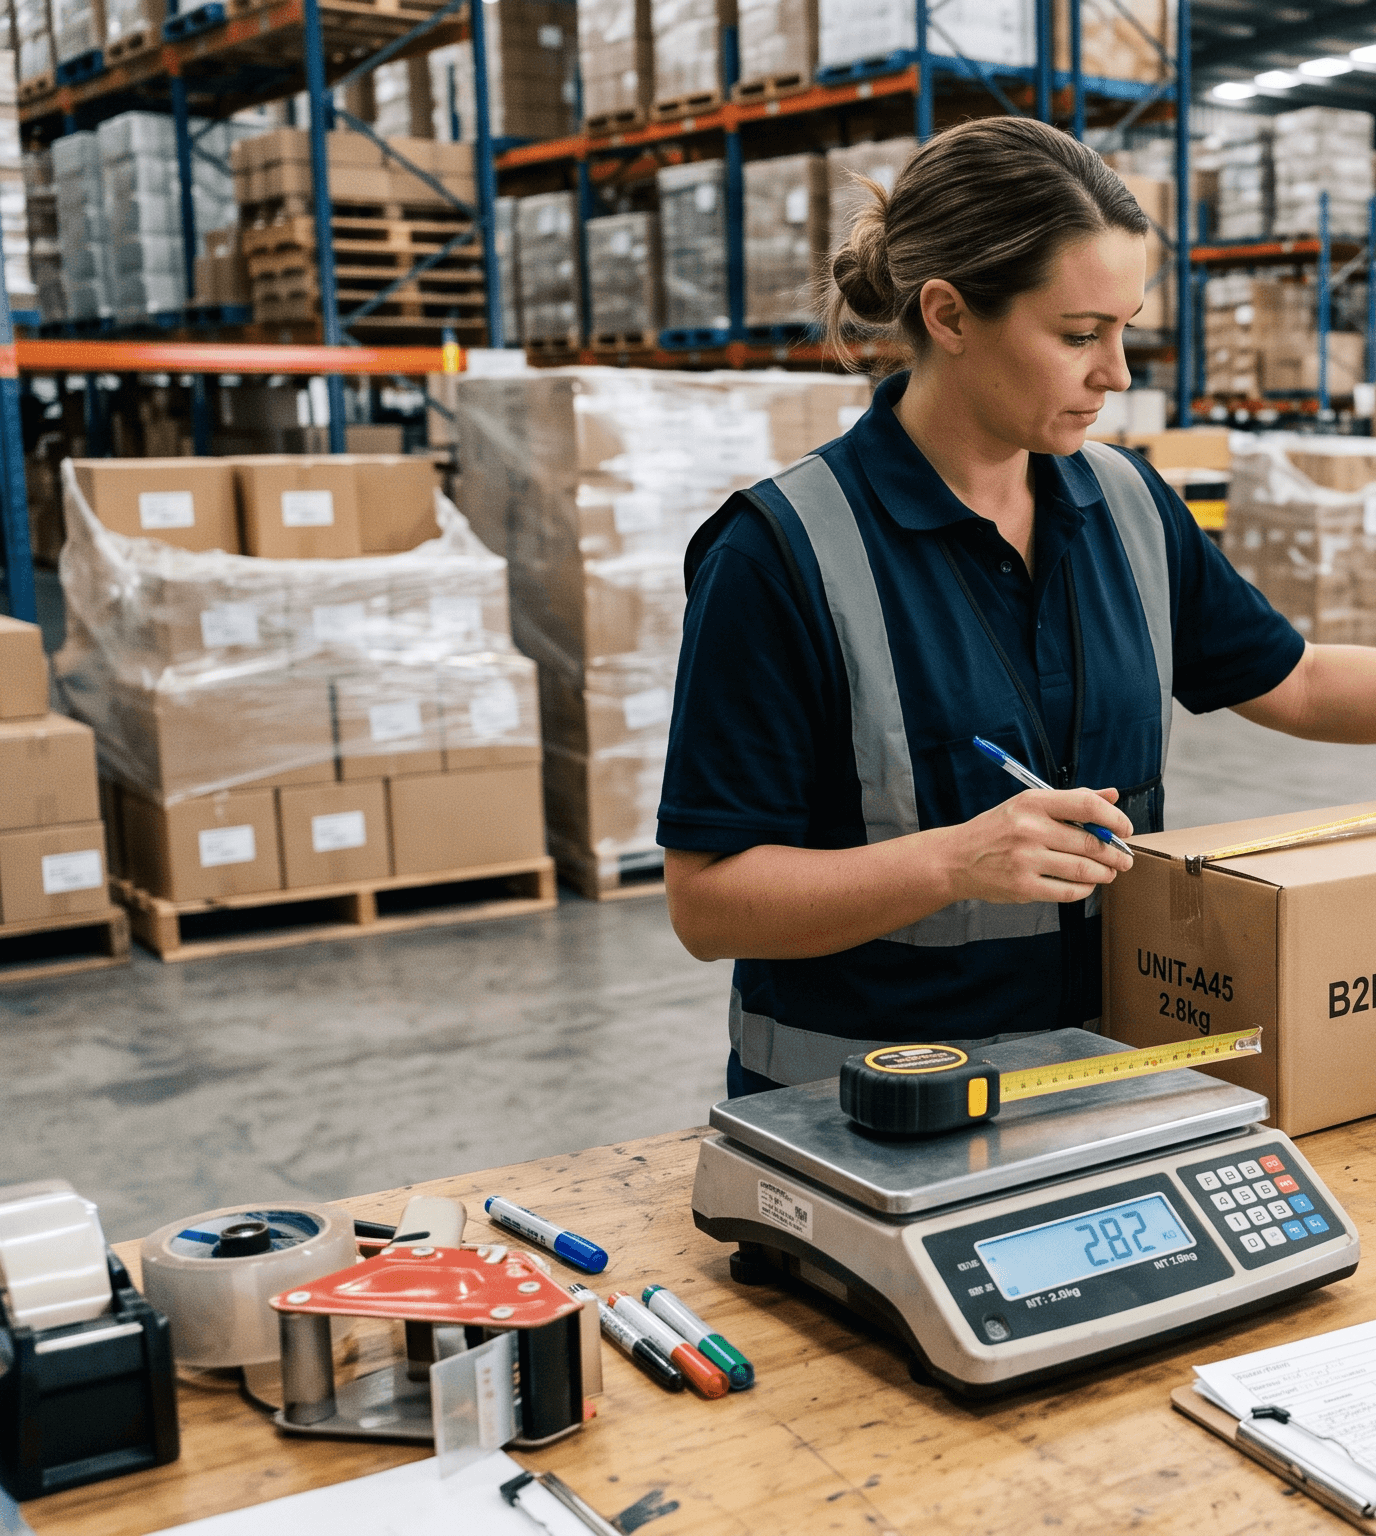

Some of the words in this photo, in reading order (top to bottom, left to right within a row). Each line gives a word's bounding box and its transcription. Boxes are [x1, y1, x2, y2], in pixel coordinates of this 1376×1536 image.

[1138, 948, 1234, 1003] UNIT-A45
[1159, 992, 1211, 1036] 2.8kg
[1075, 1210, 1156, 1267] 2.82
